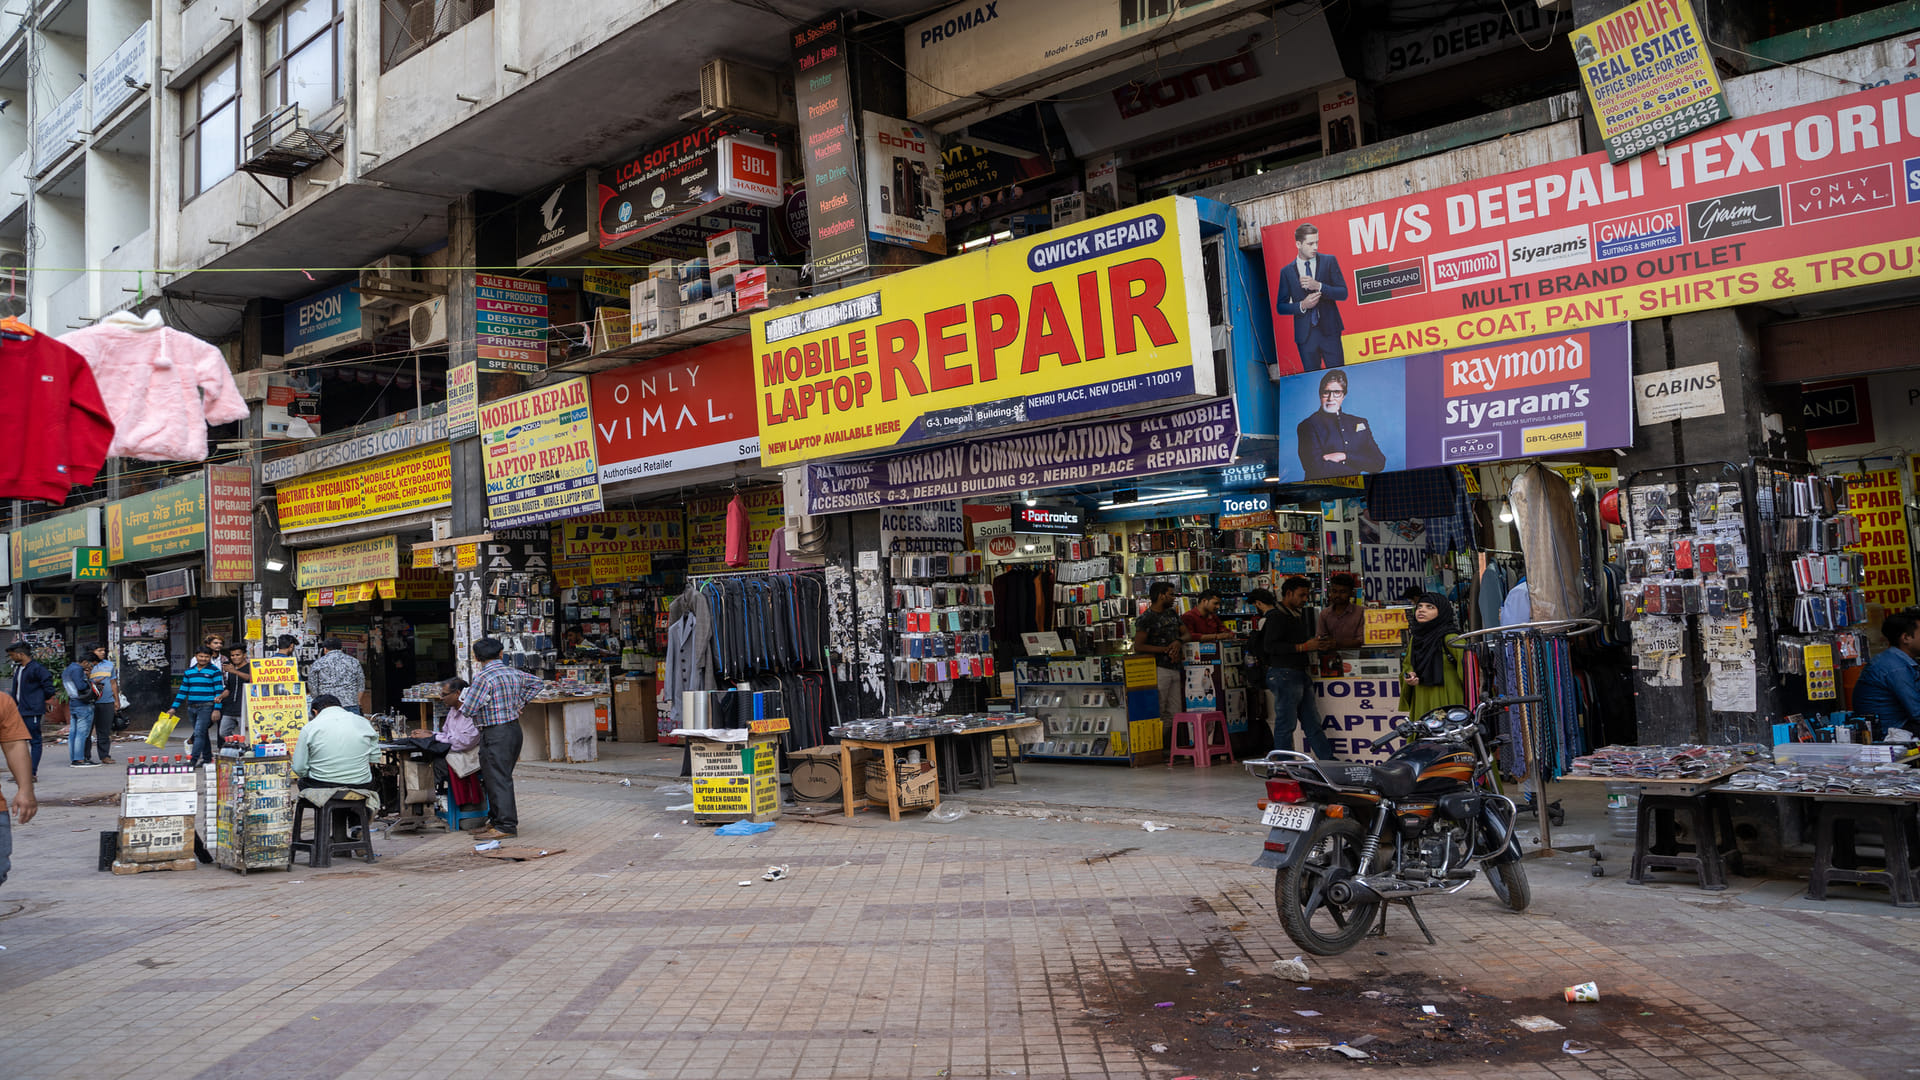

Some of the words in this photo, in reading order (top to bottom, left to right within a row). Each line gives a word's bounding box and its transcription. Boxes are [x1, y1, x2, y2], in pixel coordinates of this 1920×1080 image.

[920, 1, 999, 48] PROMAX
[1596, 0, 1682, 57] AMPLIFY
[1587, 55, 1631, 87] REAL
[1631, 24, 1695, 68] ESTATE
[809, 73, 833, 91] Printer
[1594, 80, 1625, 101] OFFICE
[1626, 67, 1654, 88] SPACE
[1655, 59, 1674, 77] FOR
[1674, 45, 1699, 69] RENT
[809, 96, 839, 119] Projector
[1605, 106, 1640, 126] Rent
[1657, 85, 1690, 105] Sale
[1693, 78, 1709, 89] in
[1636, 109, 1662, 124] Place
[1674, 93, 1697, 108] Near
[1610, 97, 1719, 147] 9899684422
[879, 132, 926, 153] Bond
[1614, 109, 1721, 159] 9899375437
[814, 141, 841, 161] Machine
[616, 159, 642, 185] LCA
[643, 140, 681, 172] SOFT
[646, 167, 666, 180] Building
[829, 166, 846, 181] Drive
[736, 181, 778, 196] HARMAN
[1809, 177, 1868, 196] ONLY
[1348, 203, 1432, 255] M/S
[1446, 154, 1645, 235] DEEPALI
[817, 218, 855, 239] Headphone
[1601, 212, 1676, 245] GWALIOR
[1033, 233, 1089, 268] QWICK
[1094, 219, 1159, 253] REPAIR
[1436, 251, 1498, 281] Raymond
[1462, 281, 1530, 310] MULTI
[1538, 265, 1628, 298] BRAND
[1637, 242, 1747, 279] OUTLET
[482, 276, 502, 287] SALE
[512, 279, 541, 292] REPAIR
[1362, 278, 1382, 291] PETER
[1383, 270, 1420, 287] ENGLAND
[486, 301, 538, 314] LAPTOP
[504, 291, 543, 304] PRODUCTS
[299, 293, 342, 327] EPSON
[487, 313, 538, 325] DESKTOP
[1358, 325, 1449, 358] JEANS,
[1456, 309, 1536, 341] COAT,
[1544, 294, 1629, 327] PANT,
[1639, 271, 1759, 311] SHIRTS
[1771, 266, 1797, 290] &
[875, 256, 1178, 403] REPAIR
[487, 336, 539, 349] PRINTER
[498, 350, 530, 360] UPS
[762, 329, 868, 388] MOBILE
[1451, 336, 1584, 391] Raymond
[488, 360, 539, 373] SPEAKERS
[614, 365, 699, 404] ONLY
[1027, 394, 1054, 409] NEHRU
[1056, 390, 1088, 405] PLACE,
[1089, 387, 1109, 399] NEW
[1110, 380, 1137, 397] DELHI
[1145, 370, 1182, 387] 110019
[1643, 373, 1717, 399] CABINS
[480, 397, 531, 431] MOBILE
[532, 381, 586, 416] REPAIR
[765, 370, 873, 426] LAPTOP
[1445, 384, 1590, 429] Siyaram's
[598, 399, 727, 444] VIMAL
[943, 411, 974, 428] Deepali
[1170, 403, 1231, 428] MOBILE
[522, 421, 541, 432] NOKIA
[1149, 434, 1161, 449] &
[1166, 424, 1225, 446] LAPTOP
[1526, 430, 1583, 443] GBTL-GRASIM
[768, 441, 787, 456] NEW
[788, 435, 822, 452] LAPTOP
[823, 424, 873, 447] AVAILABLE
[874, 419, 901, 435] HERE
[1450, 442, 1494, 454] GRADO
[264, 461, 297, 481] SPARES
[304, 440, 374, 471] ACCESSORIES
[488, 450, 537, 480] LAPTOP
[539, 439, 591, 469] REPAIR
[887, 448, 966, 487] MAHADAV
[968, 422, 1133, 474] COMMUNICATIONS
[1146, 445, 1229, 470] REPAIRING
[364, 469, 390, 485] MOBILE
[391, 462, 421, 479] LAPTOP
[602, 462, 642, 480] Authorised
[643, 458, 673, 472] Retailer
[833, 460, 874, 478] MOBILE
[913, 481, 958, 499] DEEPALI
[960, 474, 1016, 495] BUILDING
[1043, 464, 1086, 485] NEHRU
[1088, 458, 1134, 479] PLACE
[277, 487, 310, 505] DOCTRATE
[316, 476, 360, 498] SPECIALISTS
[399, 472, 437, 488] KEYBOARD
[505, 474, 527, 490] acer
[528, 470, 555, 485] TOSHIBA
[832, 475, 870, 491] LAPTOP
[214, 485, 251, 497] REPAIR
[812, 489, 881, 510] ACCESSORIES
[214, 500, 251, 511] UPGRADE
[278, 507, 293, 519] DATA
[293, 500, 324, 516] RECOVERY
[1223, 498, 1268, 513] Toreto
[215, 514, 252, 526] LAPTOP
[1028, 509, 1078, 524] Portronics
[24, 535, 44, 552] Punjab
[51, 531, 67, 545] Sind
[68, 526, 86, 540] Bank
[215, 529, 252, 541] MOBILE
[980, 525, 1007, 536] Sonia
[215, 544, 252, 556] COMPUTER
[298, 549, 337, 563] DOCTORATE
[342, 543, 379, 559] SPECIALIST
[570, 541, 627, 554] LAPTOP
[630, 538, 681, 552] REPAIR
[989, 538, 1016, 552] VIMAL
[79, 567, 111, 577] ATM
[215, 560, 252, 570] ANAND
[319, 558, 355, 572] RECOVERY
[361, 552, 390, 566] REPAIR
[357, 565, 391, 580] MOBILE
[258, 667, 291, 675] LAPTOP
[264, 659, 283, 668] OLD
[256, 674, 296, 683] AVAILABLE
[1268, 816, 1303, 829] H7319
[1272, 806, 1306, 819] DL3SE
